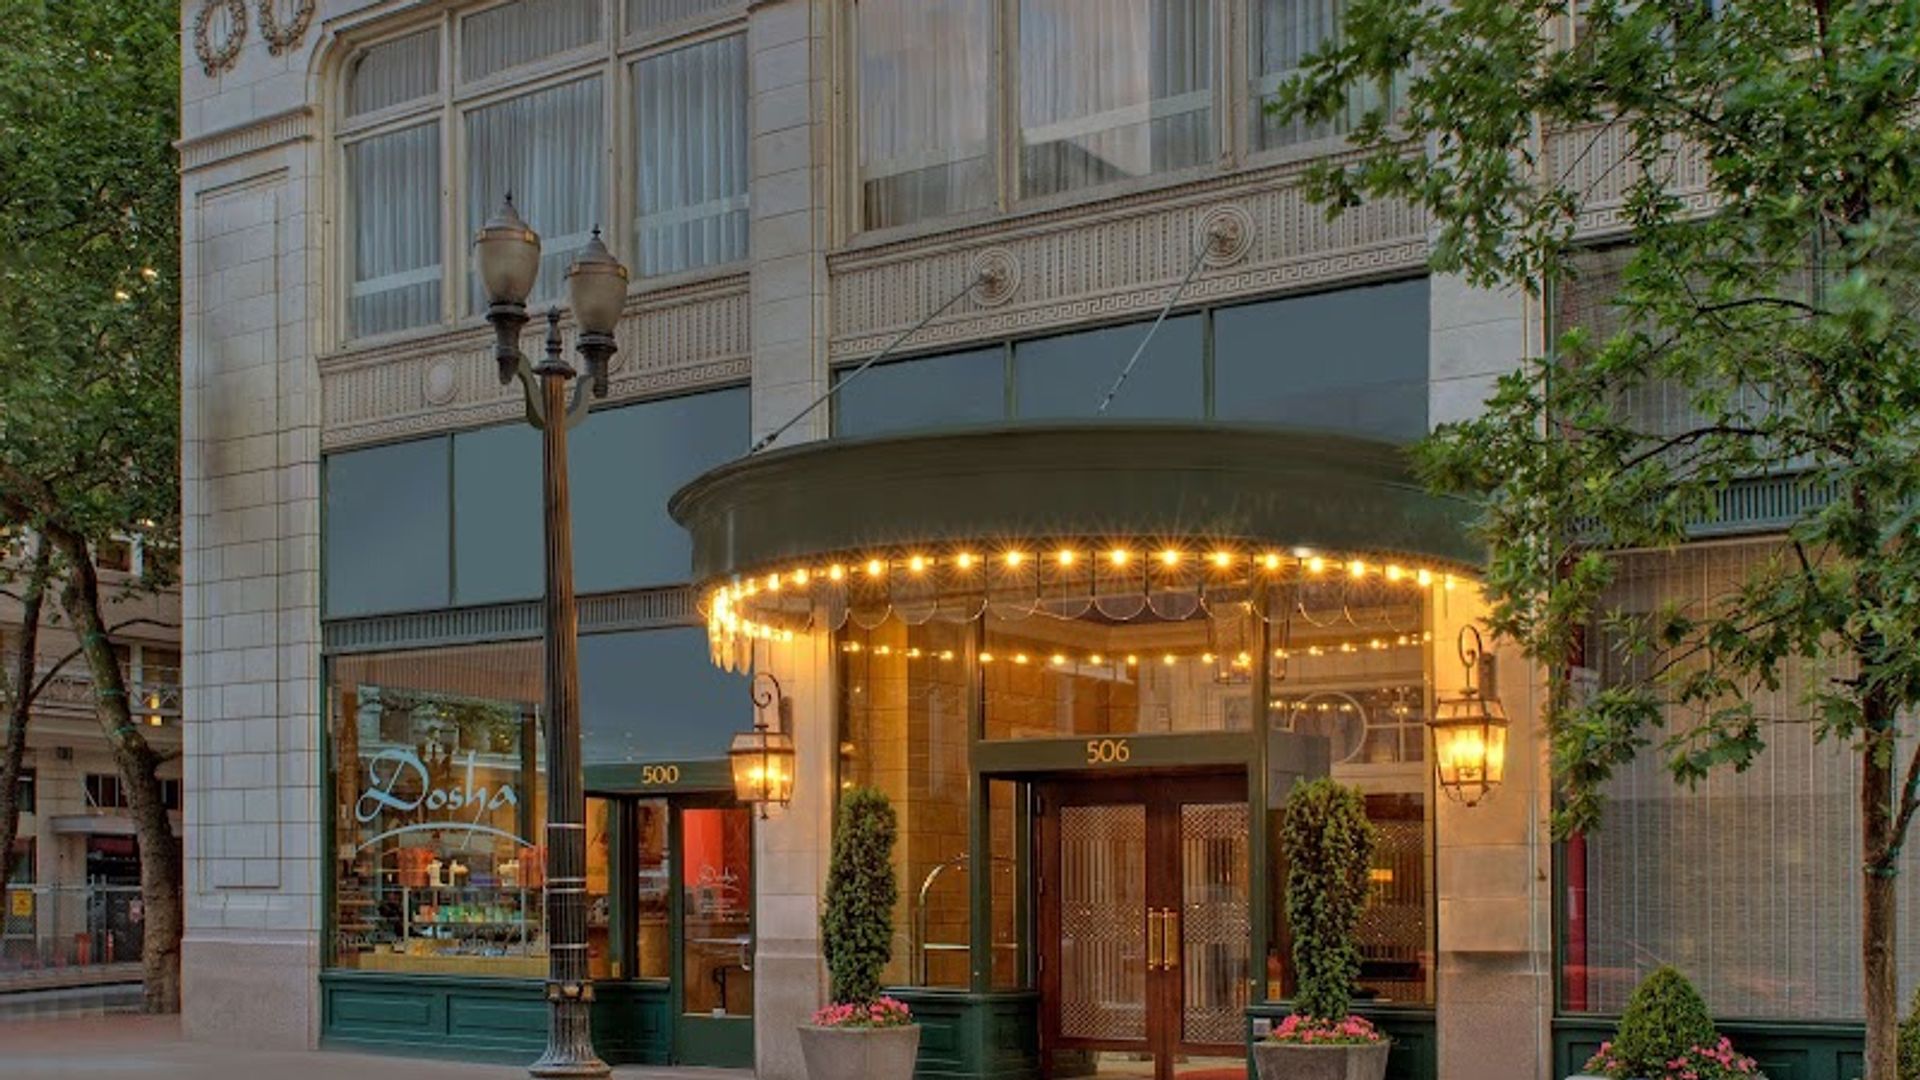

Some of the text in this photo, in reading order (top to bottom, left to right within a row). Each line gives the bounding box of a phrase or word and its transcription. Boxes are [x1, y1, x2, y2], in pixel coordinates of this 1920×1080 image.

[1087, 739, 1130, 764] 506
[642, 765, 679, 784] 500
[355, 748, 518, 850] Dosha
